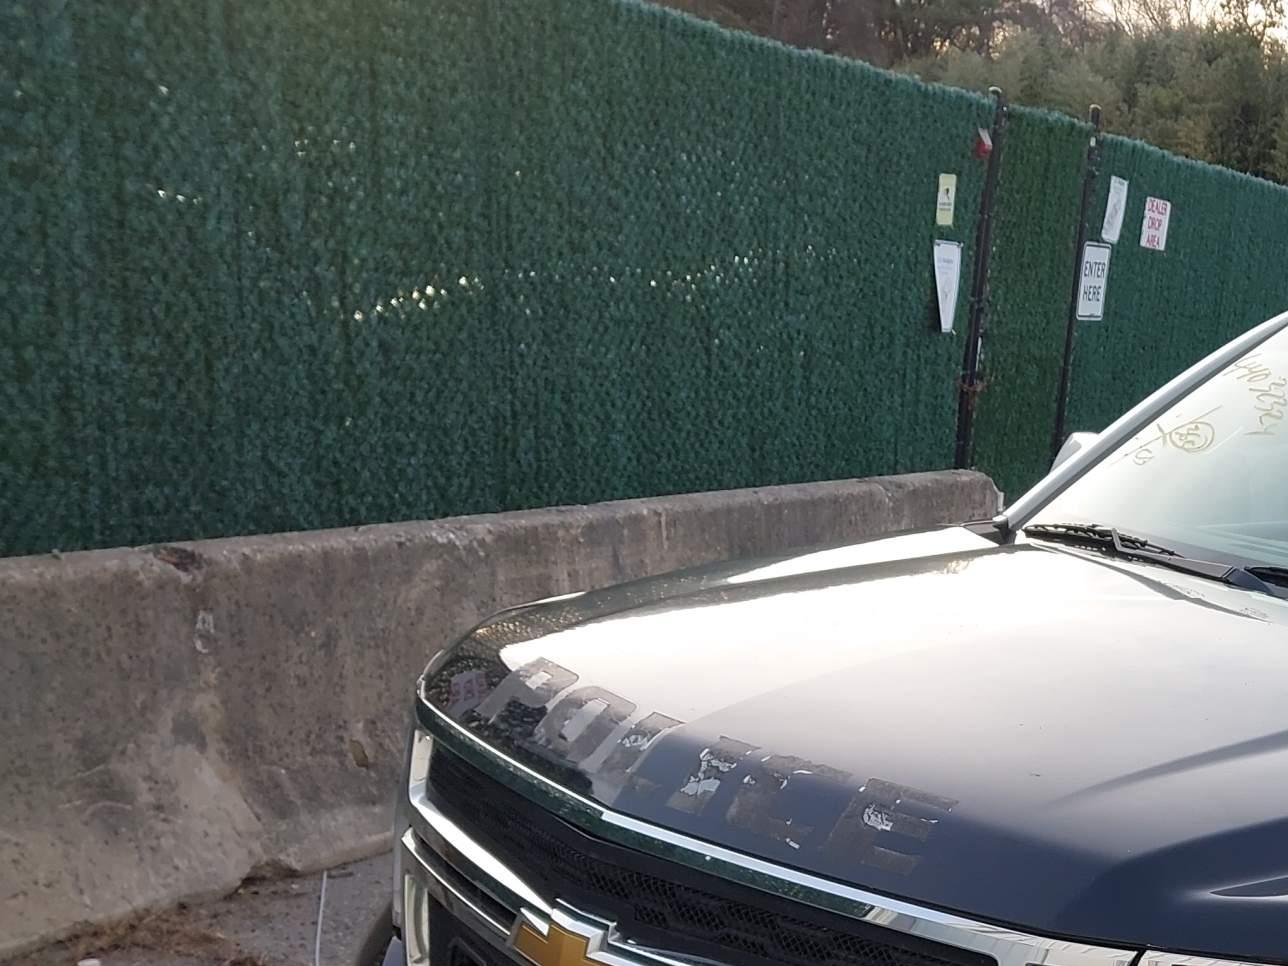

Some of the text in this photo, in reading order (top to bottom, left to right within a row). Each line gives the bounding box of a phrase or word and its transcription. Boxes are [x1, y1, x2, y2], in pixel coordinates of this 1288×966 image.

[1147, 198, 1168, 215] DEALER
[1147, 216, 1163, 231] DROP
[1146, 235, 1160, 248] AREA
[1084, 261, 1106, 279] ENTER
[1083, 285, 1102, 302] HERE
